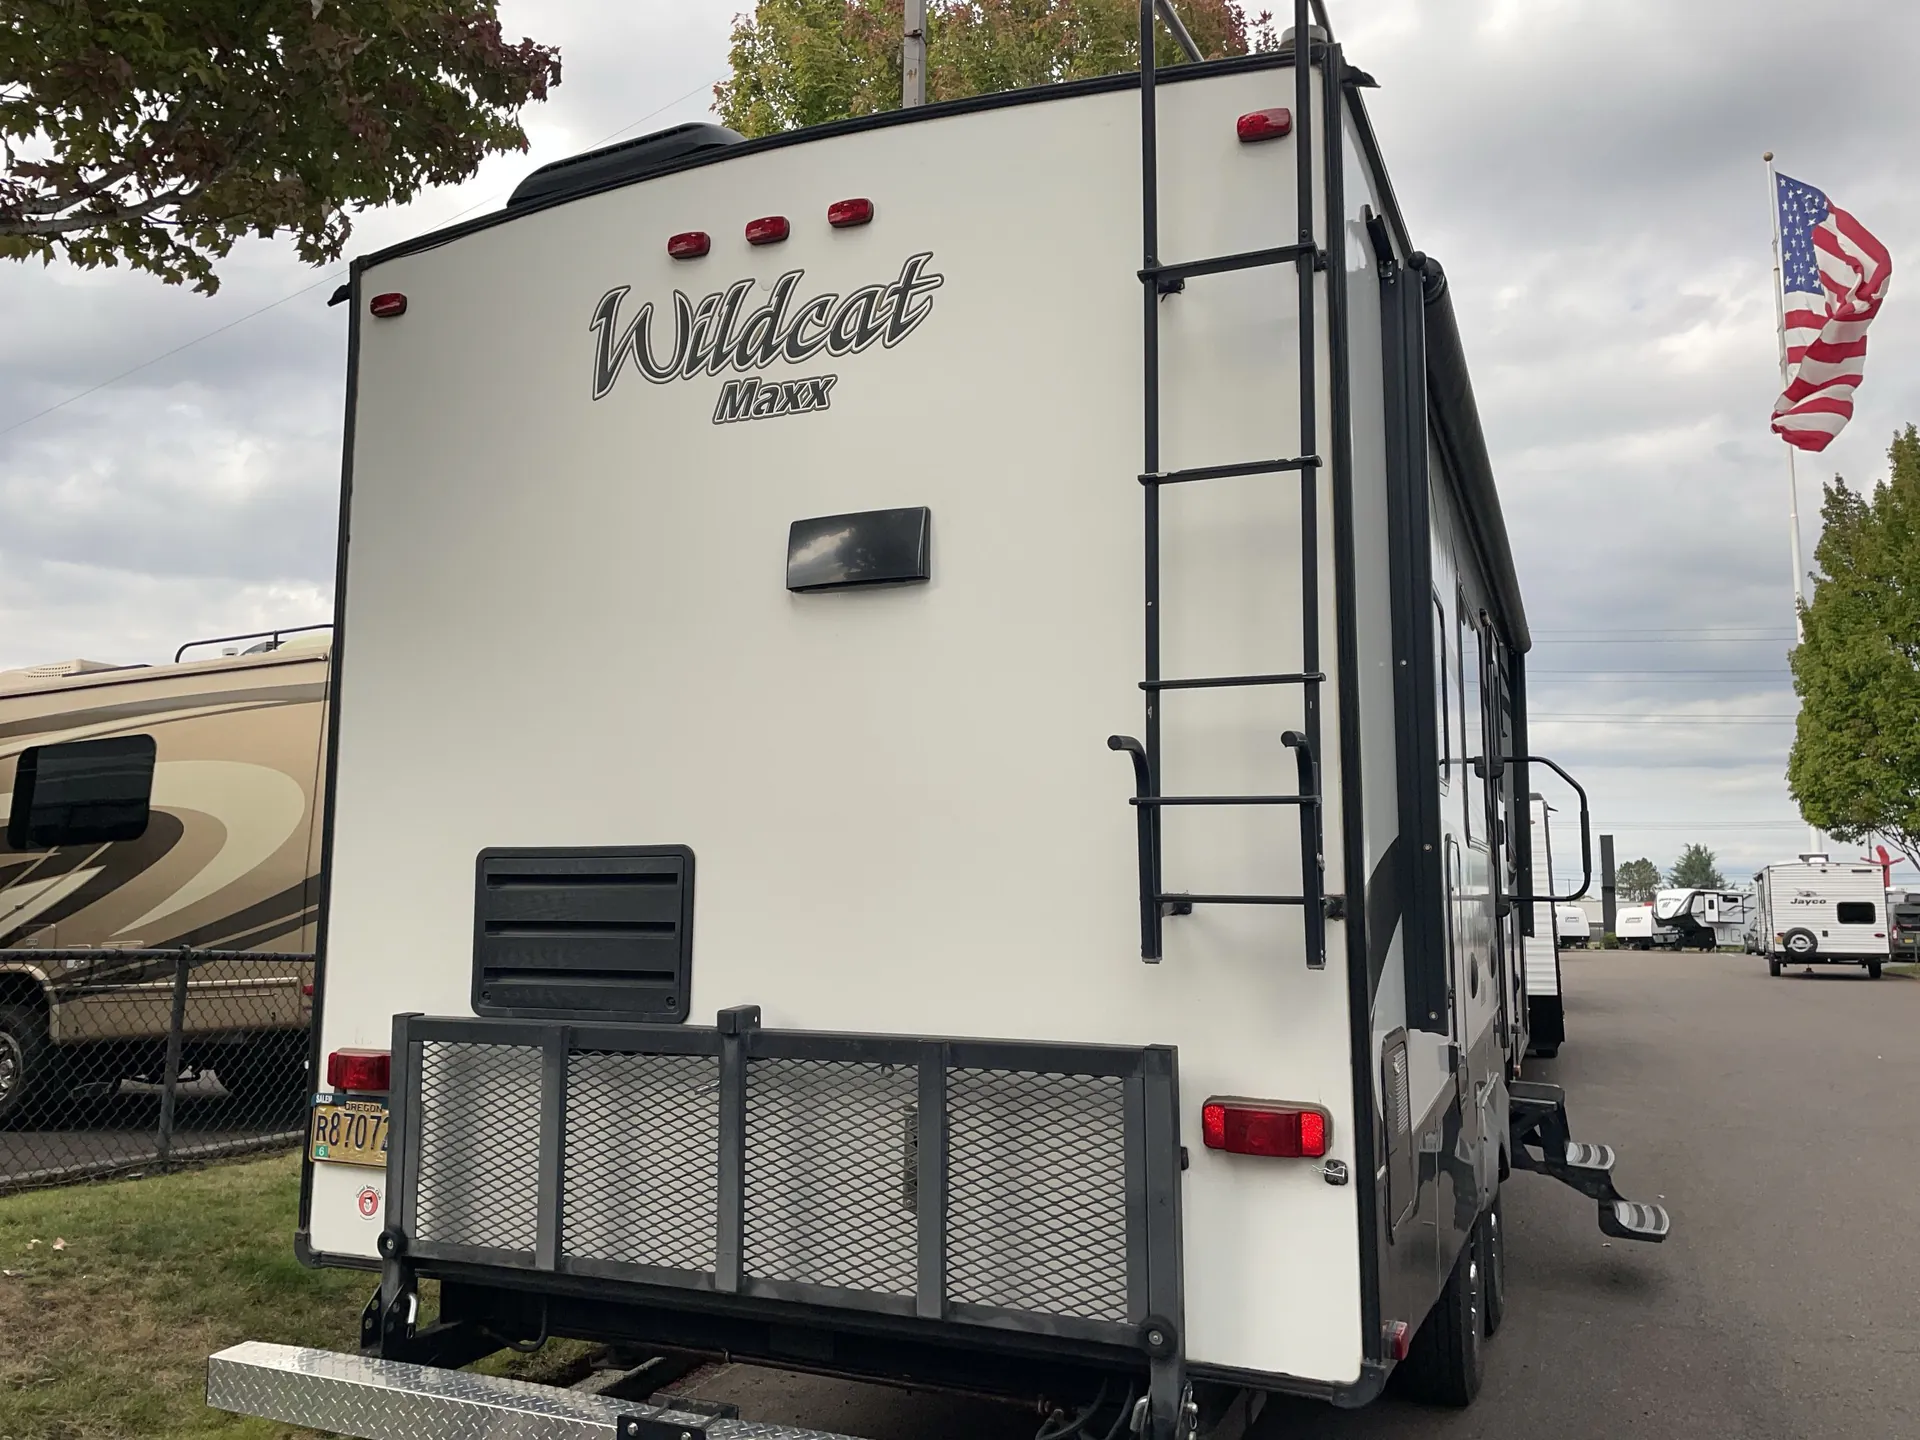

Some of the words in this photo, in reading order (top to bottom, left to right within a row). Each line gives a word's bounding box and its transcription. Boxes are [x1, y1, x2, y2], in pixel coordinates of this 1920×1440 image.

[589, 251, 944, 400] Wildcat
[712, 374, 838, 424] Maxx
[1790, 898, 1827, 906] Jayco
[345, 1102, 382, 1113] OREGON
[318, 1146, 325, 1156] 6
